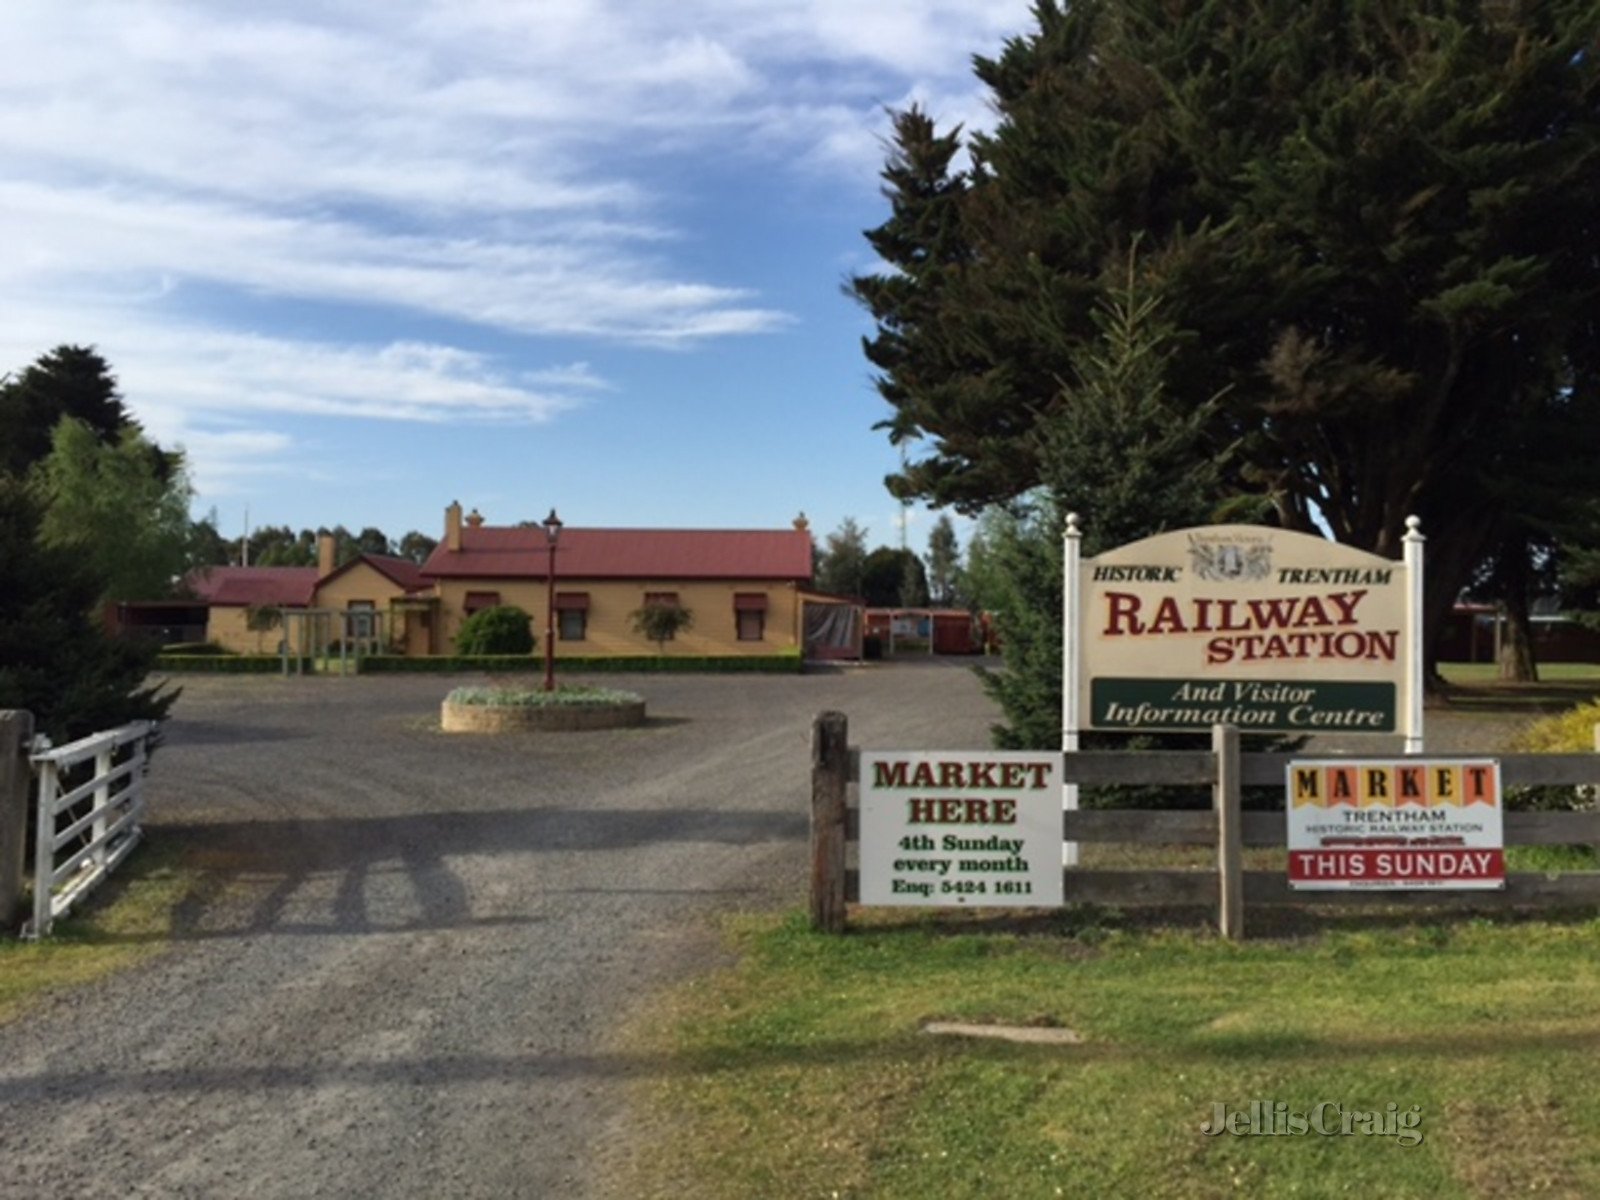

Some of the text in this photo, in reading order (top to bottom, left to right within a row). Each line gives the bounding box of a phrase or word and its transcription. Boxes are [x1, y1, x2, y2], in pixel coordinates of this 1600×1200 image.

[1092, 565, 1392, 585] HISTORIC TRENTHAM
[1103, 590, 1367, 636] RAILWAY
[1207, 631, 1398, 664] STATION
[1172, 682, 1315, 702] And Visitor
[1105, 703, 1384, 727] Information Centre
[873, 761, 1052, 789] MARKET
[1297, 768, 1486, 798] MARKET
[907, 799, 1017, 824] HERE
[1341, 810, 1446, 823] TRENTHAM
[1306, 823, 1483, 834] HISTORIC RAILWAY STATION
[898, 835, 1024, 855] 4th Sunday
[893, 857, 1029, 875] every month
[1298, 853, 1492, 876] THIS SUNDAY
[892, 880, 1032, 897] Enq: 5424 1611
